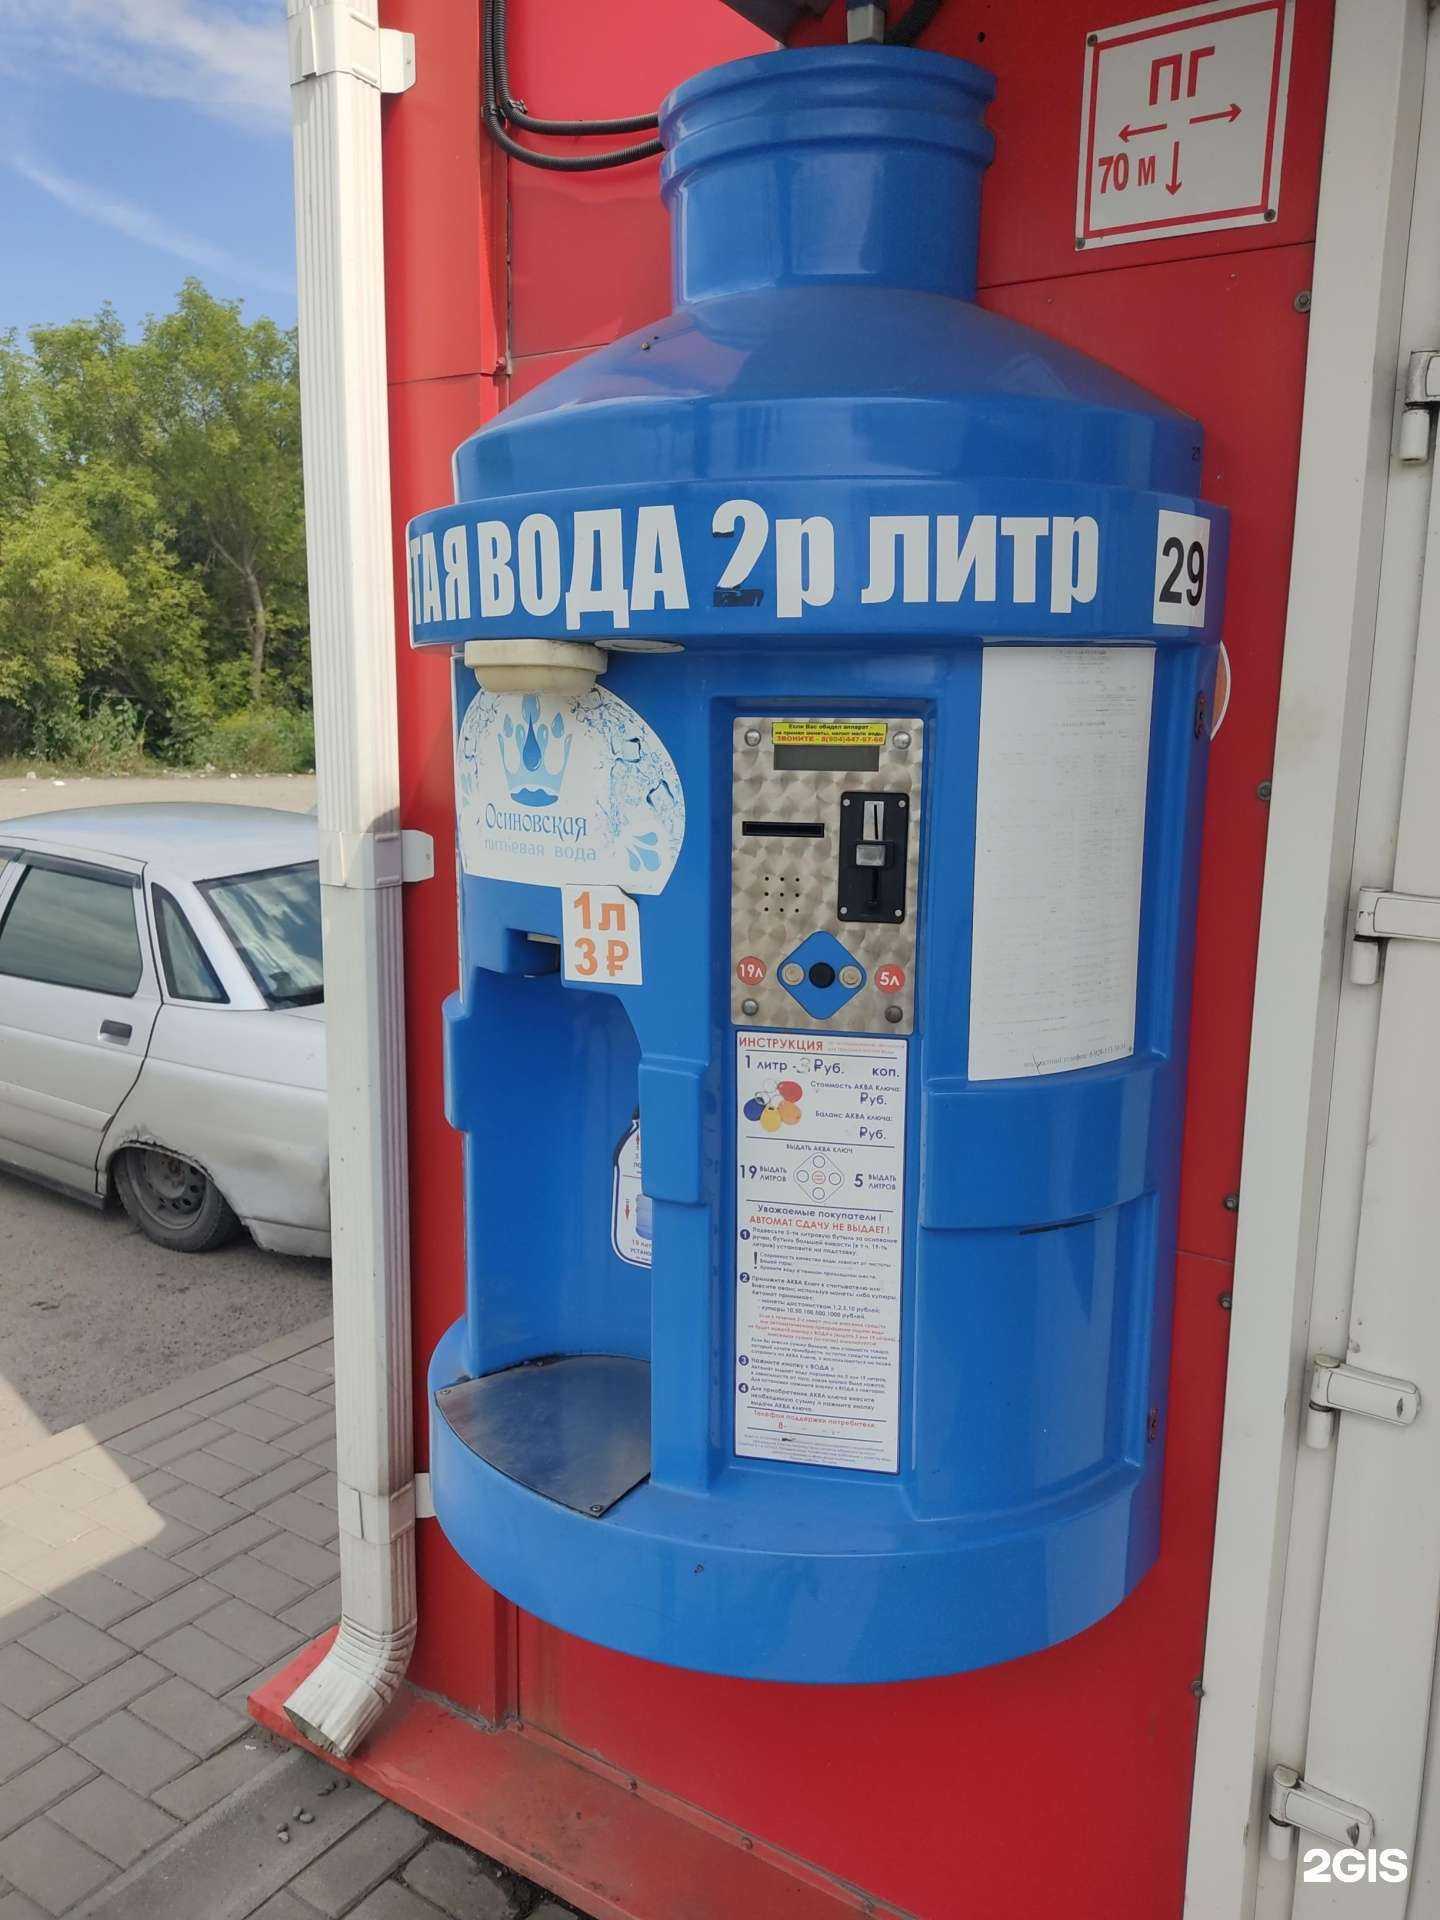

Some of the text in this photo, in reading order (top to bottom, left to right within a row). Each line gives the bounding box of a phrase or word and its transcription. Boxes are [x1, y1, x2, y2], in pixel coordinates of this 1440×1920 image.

[1149, 46, 1215, 106] ПГ
[1098, 152, 1129, 194] 70
[477, 504, 690, 630] ВОДА
[1158, 536, 1205, 608] 29
[776, 735, 815, 743] ЗВОНИТЕ
[485, 803, 587, 841] Осиновская
[555, 845, 597, 863] вода
[574, 891, 591, 929] 1
[574, 937, 598, 976] 3
[739, 1037, 823, 1051] ИНСТРУКЦИЯ
[757, 1061, 788, 1071] литр
[872, 1067, 900, 1078] коп.
[811, 1080, 852, 1090] Стоимость
[854, 1083, 873, 1091] АКВА
[815, 1110, 844, 1119] Баланс
[845, 1112, 865, 1120] АКВА
[786, 1143, 812, 1151] ВЫДАТЬ
[833, 1146, 853, 1154] КЛЮЧ
[740, 1164, 787, 1179] 19 ВЫДАТЬ
[759, 1174, 787, 1182] ЛИТРОВ
[854, 1173, 896, 1188] 5 ВЫДАТЬ
[868, 1183, 896, 1191] ЛИТРОВ
[757, 1204, 815, 1217] Уважаемые
[818, 1211, 876, 1222] покупатели
[750, 1216, 793, 1227] АВТОМАТ
[795, 1219, 829, 1231] СДАЧУ
[832, 1222, 844, 1231] НЕ
[847, 1224, 885, 1234] ВЫДАЕТ
